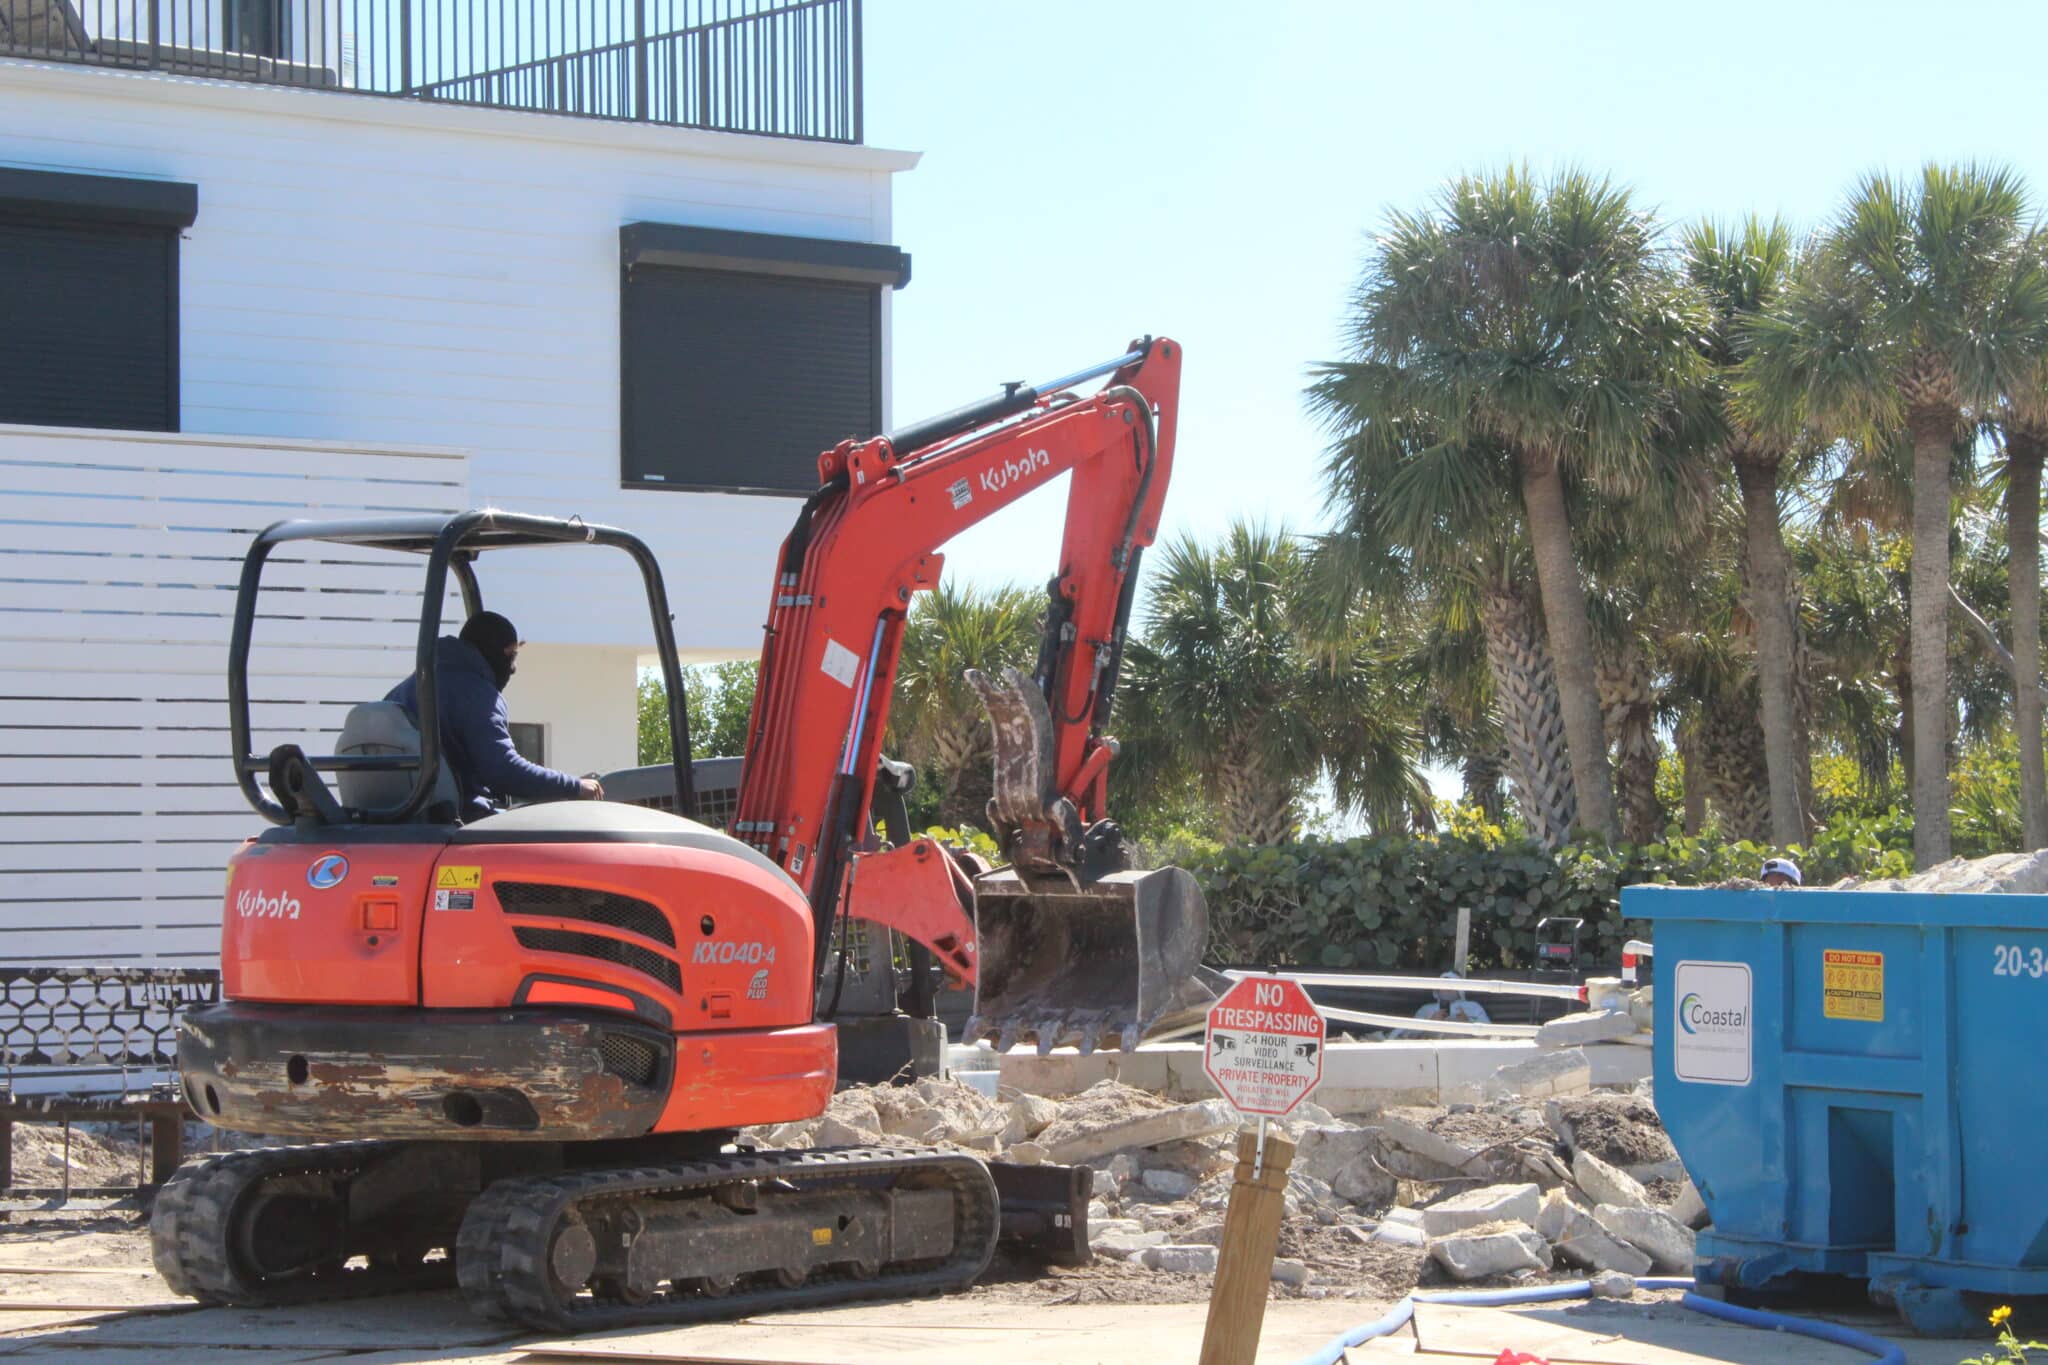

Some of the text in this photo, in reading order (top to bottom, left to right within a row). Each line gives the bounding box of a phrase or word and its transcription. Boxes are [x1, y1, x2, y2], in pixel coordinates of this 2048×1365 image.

[980, 447, 1050, 492] Kubota
[237, 890, 301, 920] Kubota
[691, 941, 776, 965] KX040-4
[746, 989, 767, 1000] PLUS
[1255, 983, 1284, 1007] NO
[1216, 1008, 1318, 1033] TRESPASSING
[1691, 1004, 1747, 1027] Coastal
[1244, 1033, 1287, 1047] 24 HOUR
[1253, 1047, 1278, 1058] VIDEO
[1234, 1057, 1295, 1072] SURVEILLANCE
[1218, 1068, 1309, 1088] PRIVATE PROPERTY
